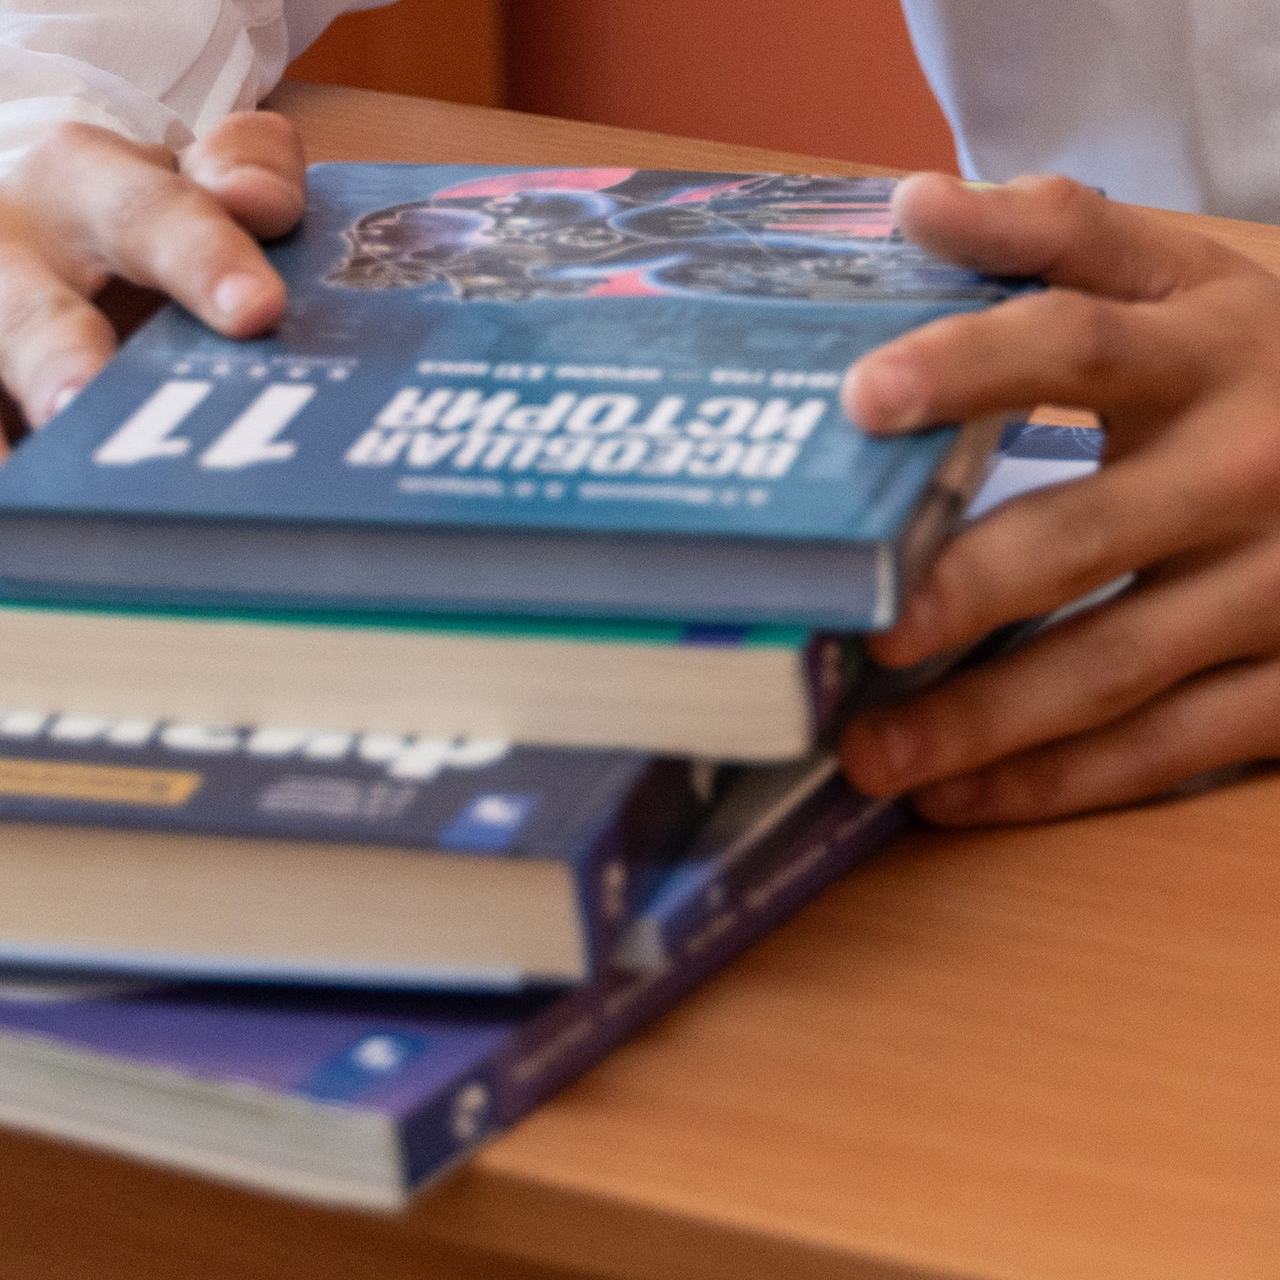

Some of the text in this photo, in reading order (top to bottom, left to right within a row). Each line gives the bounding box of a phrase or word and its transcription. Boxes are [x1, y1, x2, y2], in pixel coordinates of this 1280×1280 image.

[93, 379, 317, 471] 11
[374, 386, 828, 442] ИСТОРИЯ
[343, 431, 801, 480] ВСЕОБЩАЯ
